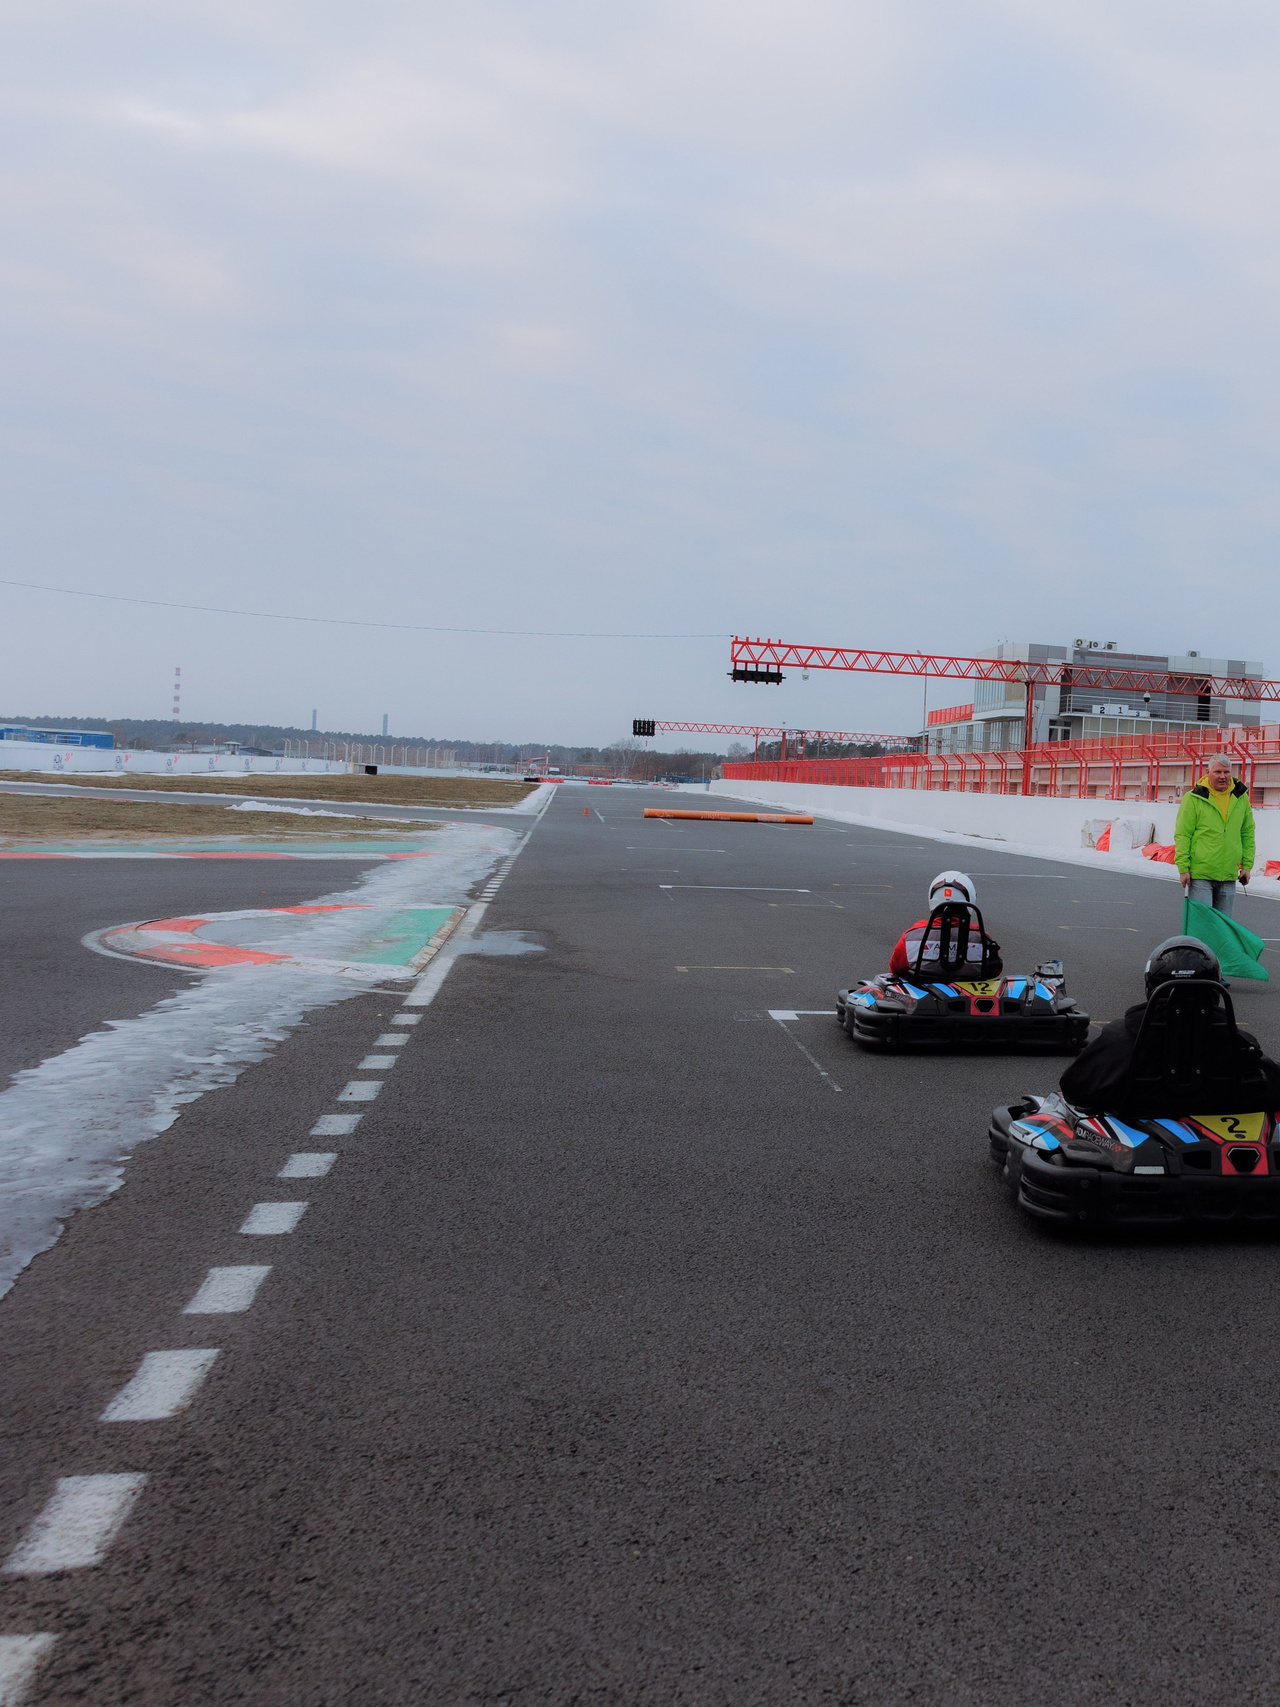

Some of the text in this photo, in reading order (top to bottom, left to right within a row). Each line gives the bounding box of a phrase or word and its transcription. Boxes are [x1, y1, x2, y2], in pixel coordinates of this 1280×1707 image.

[1100, 706, 1105, 714] 2
[1118, 706, 1123, 714] 1
[968, 982, 992, 991] 12
[1220, 1117, 1247, 1134] 2
